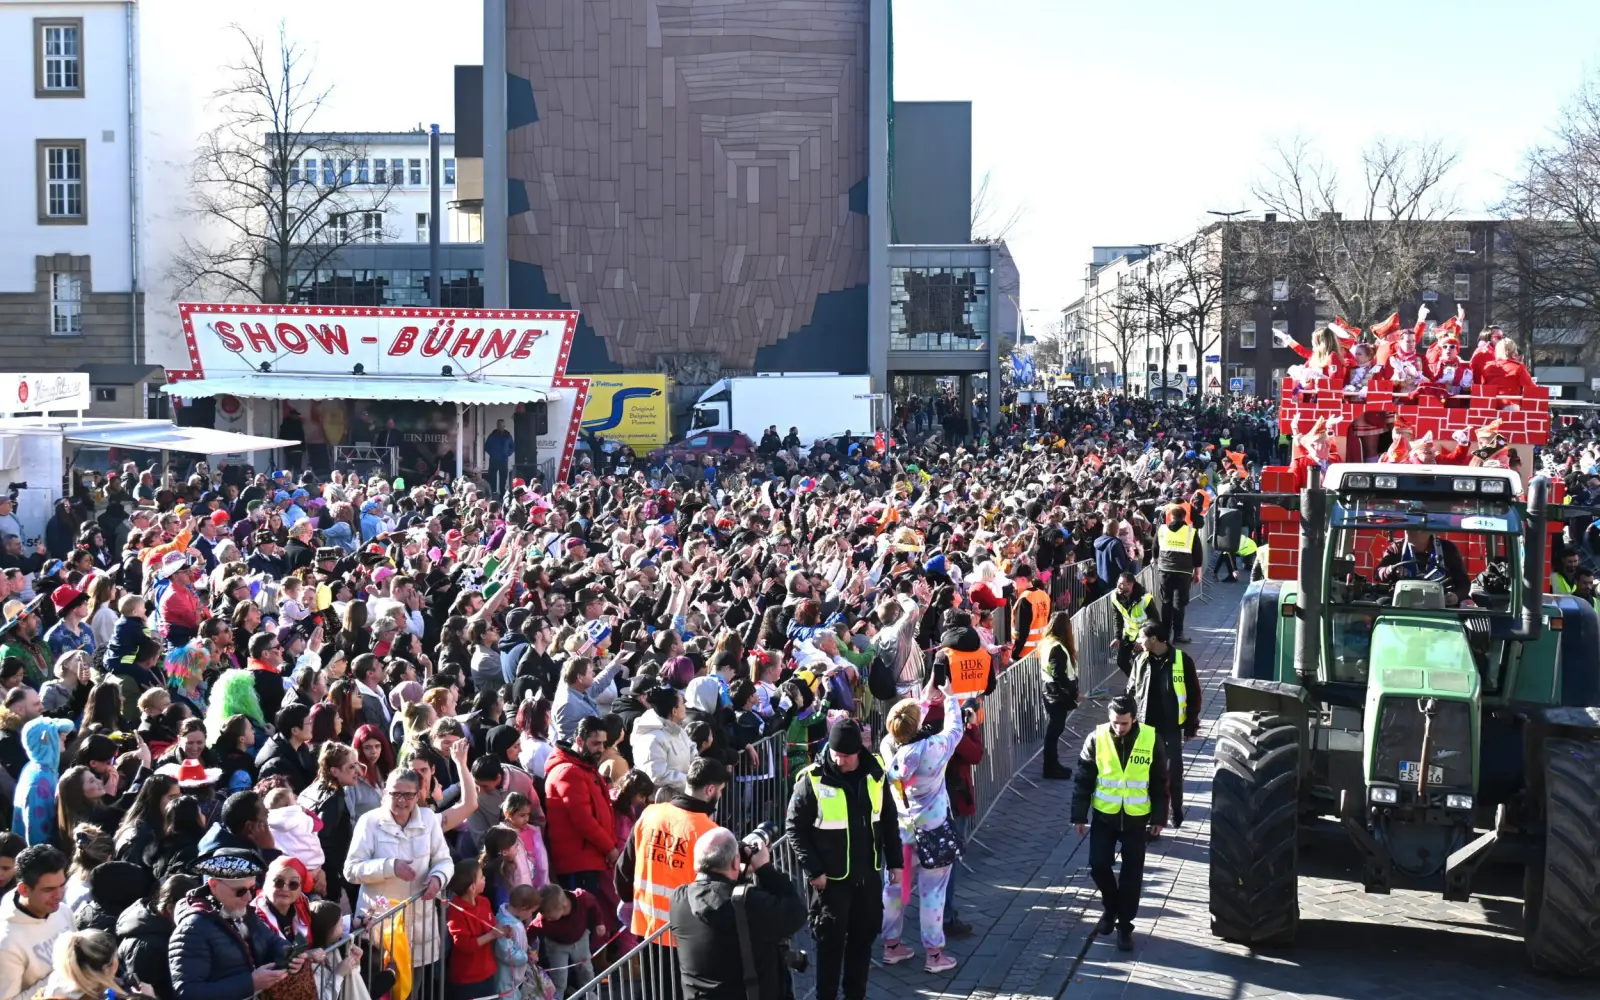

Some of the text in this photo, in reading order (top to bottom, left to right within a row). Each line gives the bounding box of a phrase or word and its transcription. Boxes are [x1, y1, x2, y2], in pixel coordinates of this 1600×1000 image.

[215, 320, 349, 355] SHOW
[387, 319, 543, 360] BÜHNE
[424, 433, 449, 443] BIER
[960, 659, 983, 669] HDK
[960, 671, 983, 680] Helfer
[1130, 755, 1150, 766] 1004
[1400, 771, 1414, 781] FS
[650, 829, 689, 854] HDK
